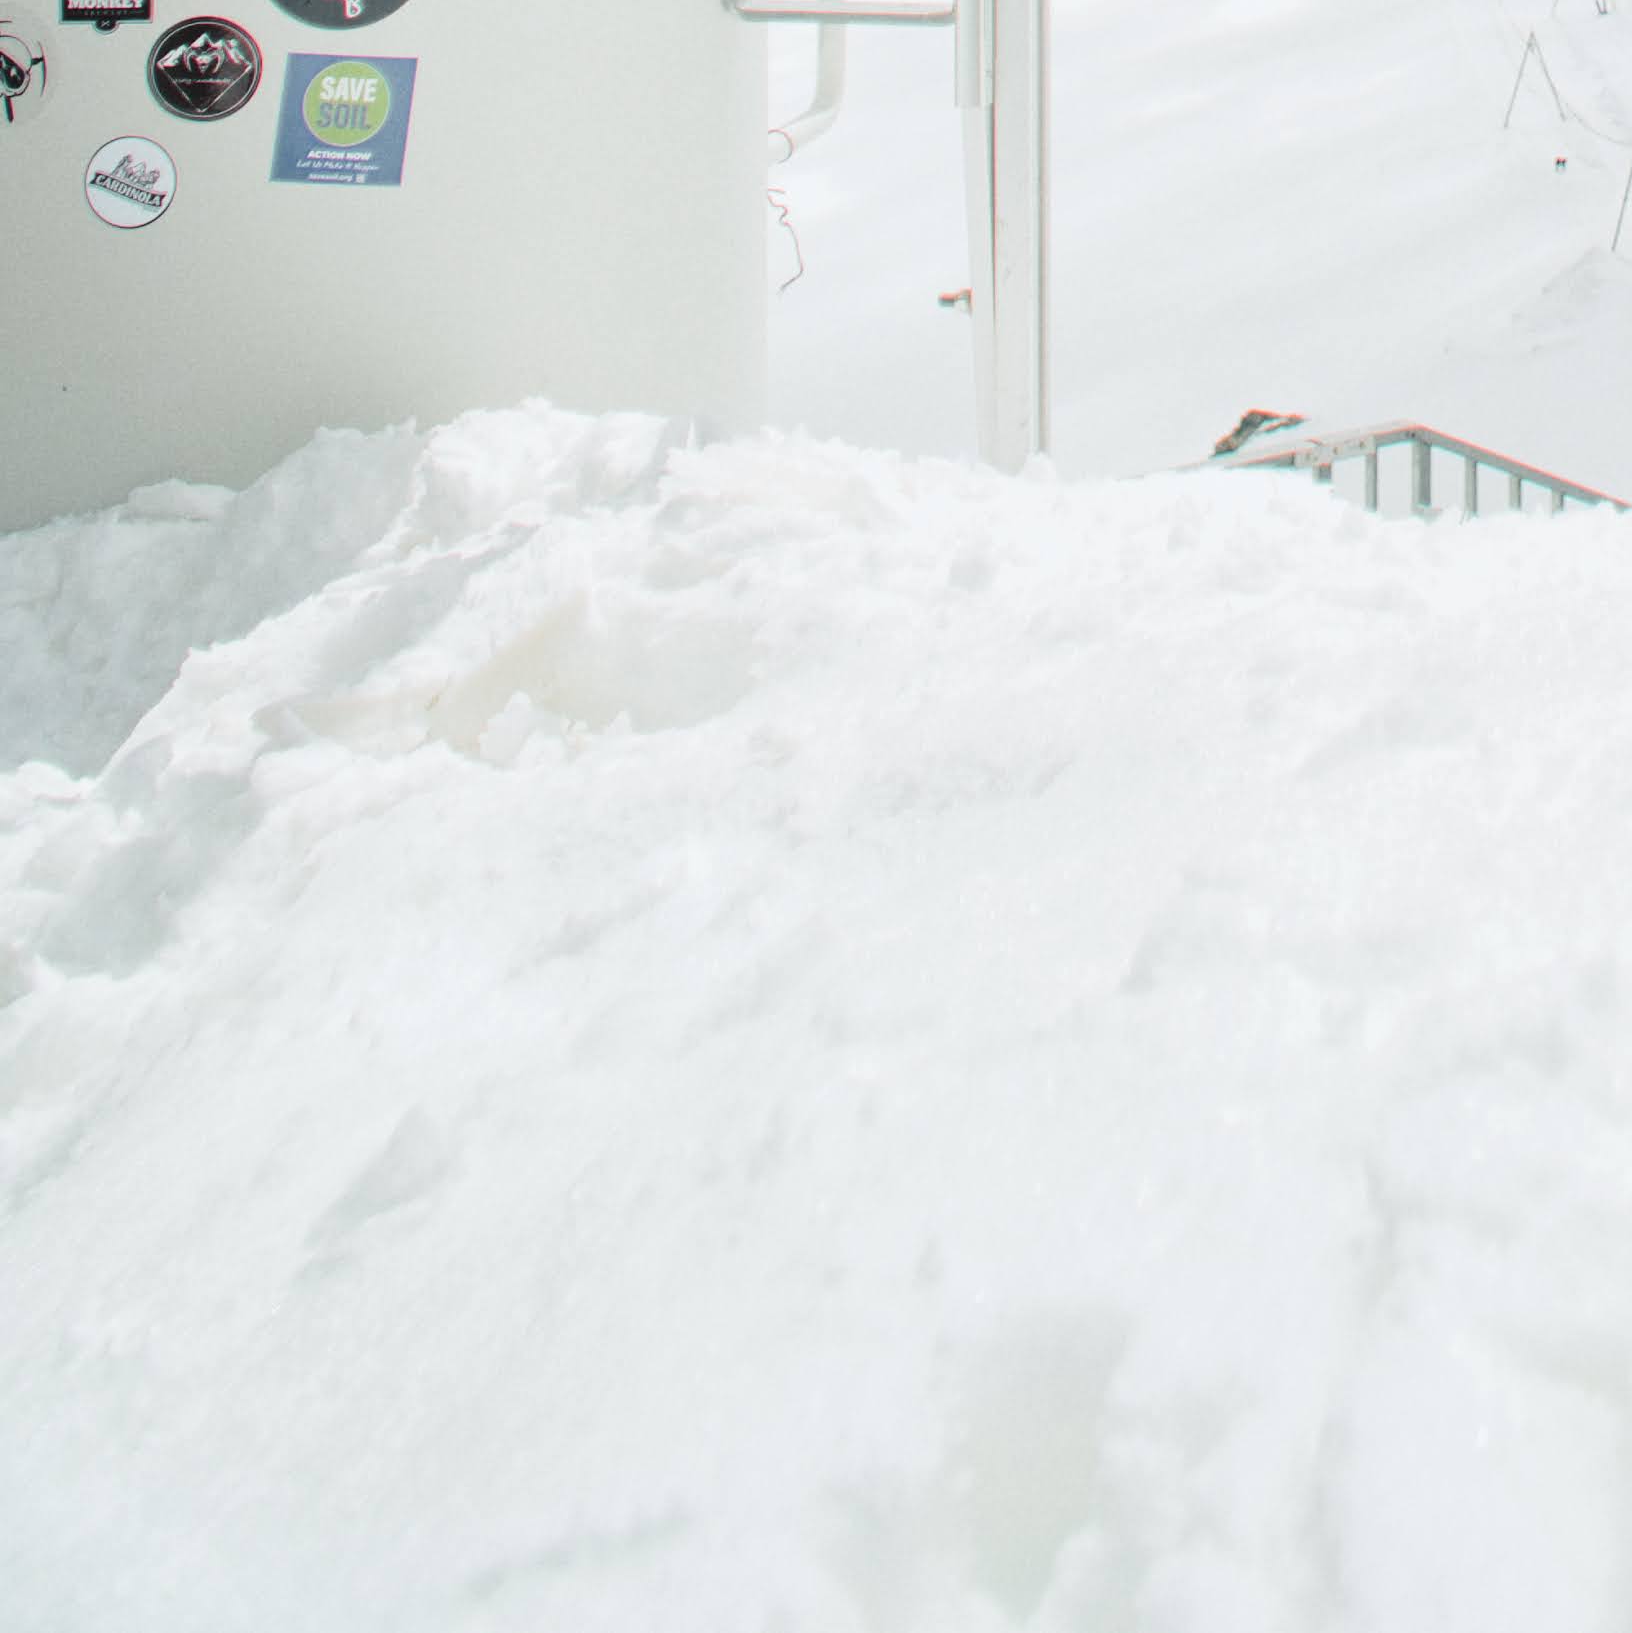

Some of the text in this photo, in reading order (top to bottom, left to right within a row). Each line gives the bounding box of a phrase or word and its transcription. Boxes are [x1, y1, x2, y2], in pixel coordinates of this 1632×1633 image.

[319, 75, 378, 103] SAVE
[316, 101, 371, 131] SOIL
[306, 150, 372, 161] ACTION NOW
[95, 174, 165, 208] CARDINOLA
